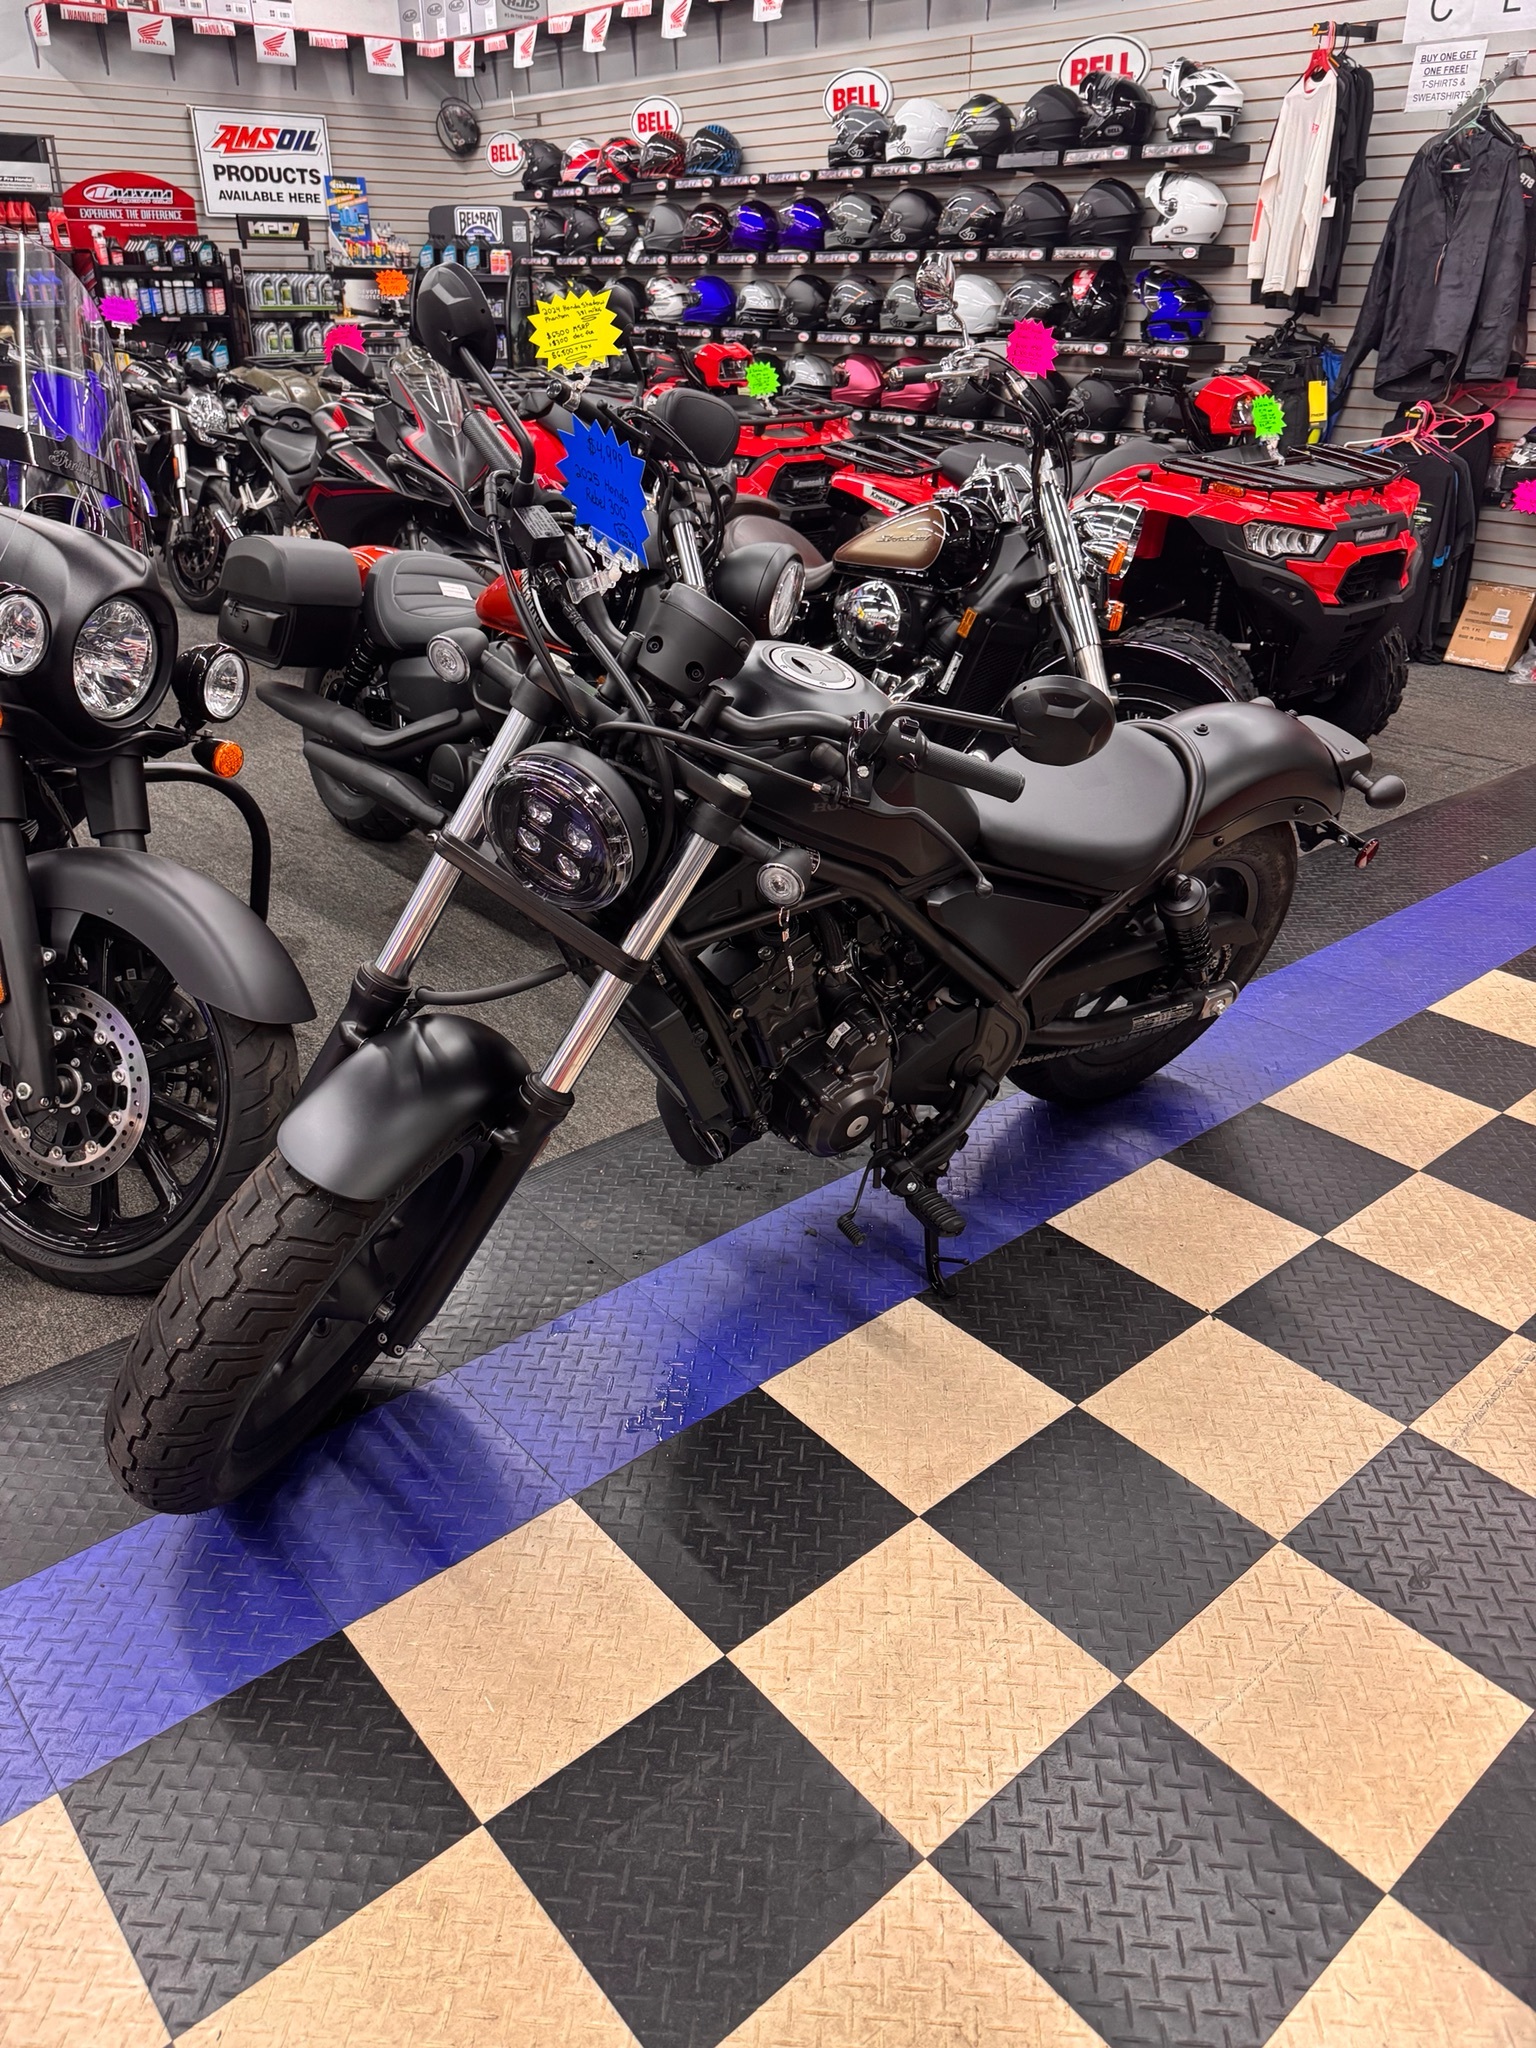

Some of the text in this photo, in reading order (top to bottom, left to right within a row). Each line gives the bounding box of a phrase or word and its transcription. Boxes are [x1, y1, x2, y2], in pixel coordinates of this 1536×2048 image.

[67, 9, 91, 22] WANNA
[91, 11, 106, 24] RIDE
[138, 38, 167, 47] HONDA
[264, 50, 290, 58] HONDA
[1421, 50, 1478, 63] BUY ONE GET
[1423, 64, 1469, 76] ONE FREE!
[1422, 78, 1466, 88] T-SHIRTS &
[832, 84, 880, 112] BELL
[1412, 90, 1472, 102] SWEATSHIRTS
[637, 110, 673, 133] BELL
[1107, 126, 1121, 134] BELL
[211, 125, 318, 154] AMSOIL
[491, 143, 518, 163] BELL
[1198, 143, 1211, 151] BELL
[213, 164, 321, 185] PRODUCTS
[1520, 172, 1535, 189] 978
[109, 188, 173, 199] MAXIMA
[219, 190, 321, 204] AVAILABLE HERE
[80, 208, 182, 220] EXPERIENCE THE DIFFERENCE
[542, 300, 604, 316] 2024 Honda Shadow
[545, 313, 569, 323] Phantom
[573, 322, 590, 333] MSRP
[587, 436, 624, 474] $4,999
[575, 463, 630, 506] 2025 Honda
[585, 487, 627, 520] Rebel 300
[870, 491, 899, 509] Kawasaki
[1356, 525, 1388, 543] Kawasaki
